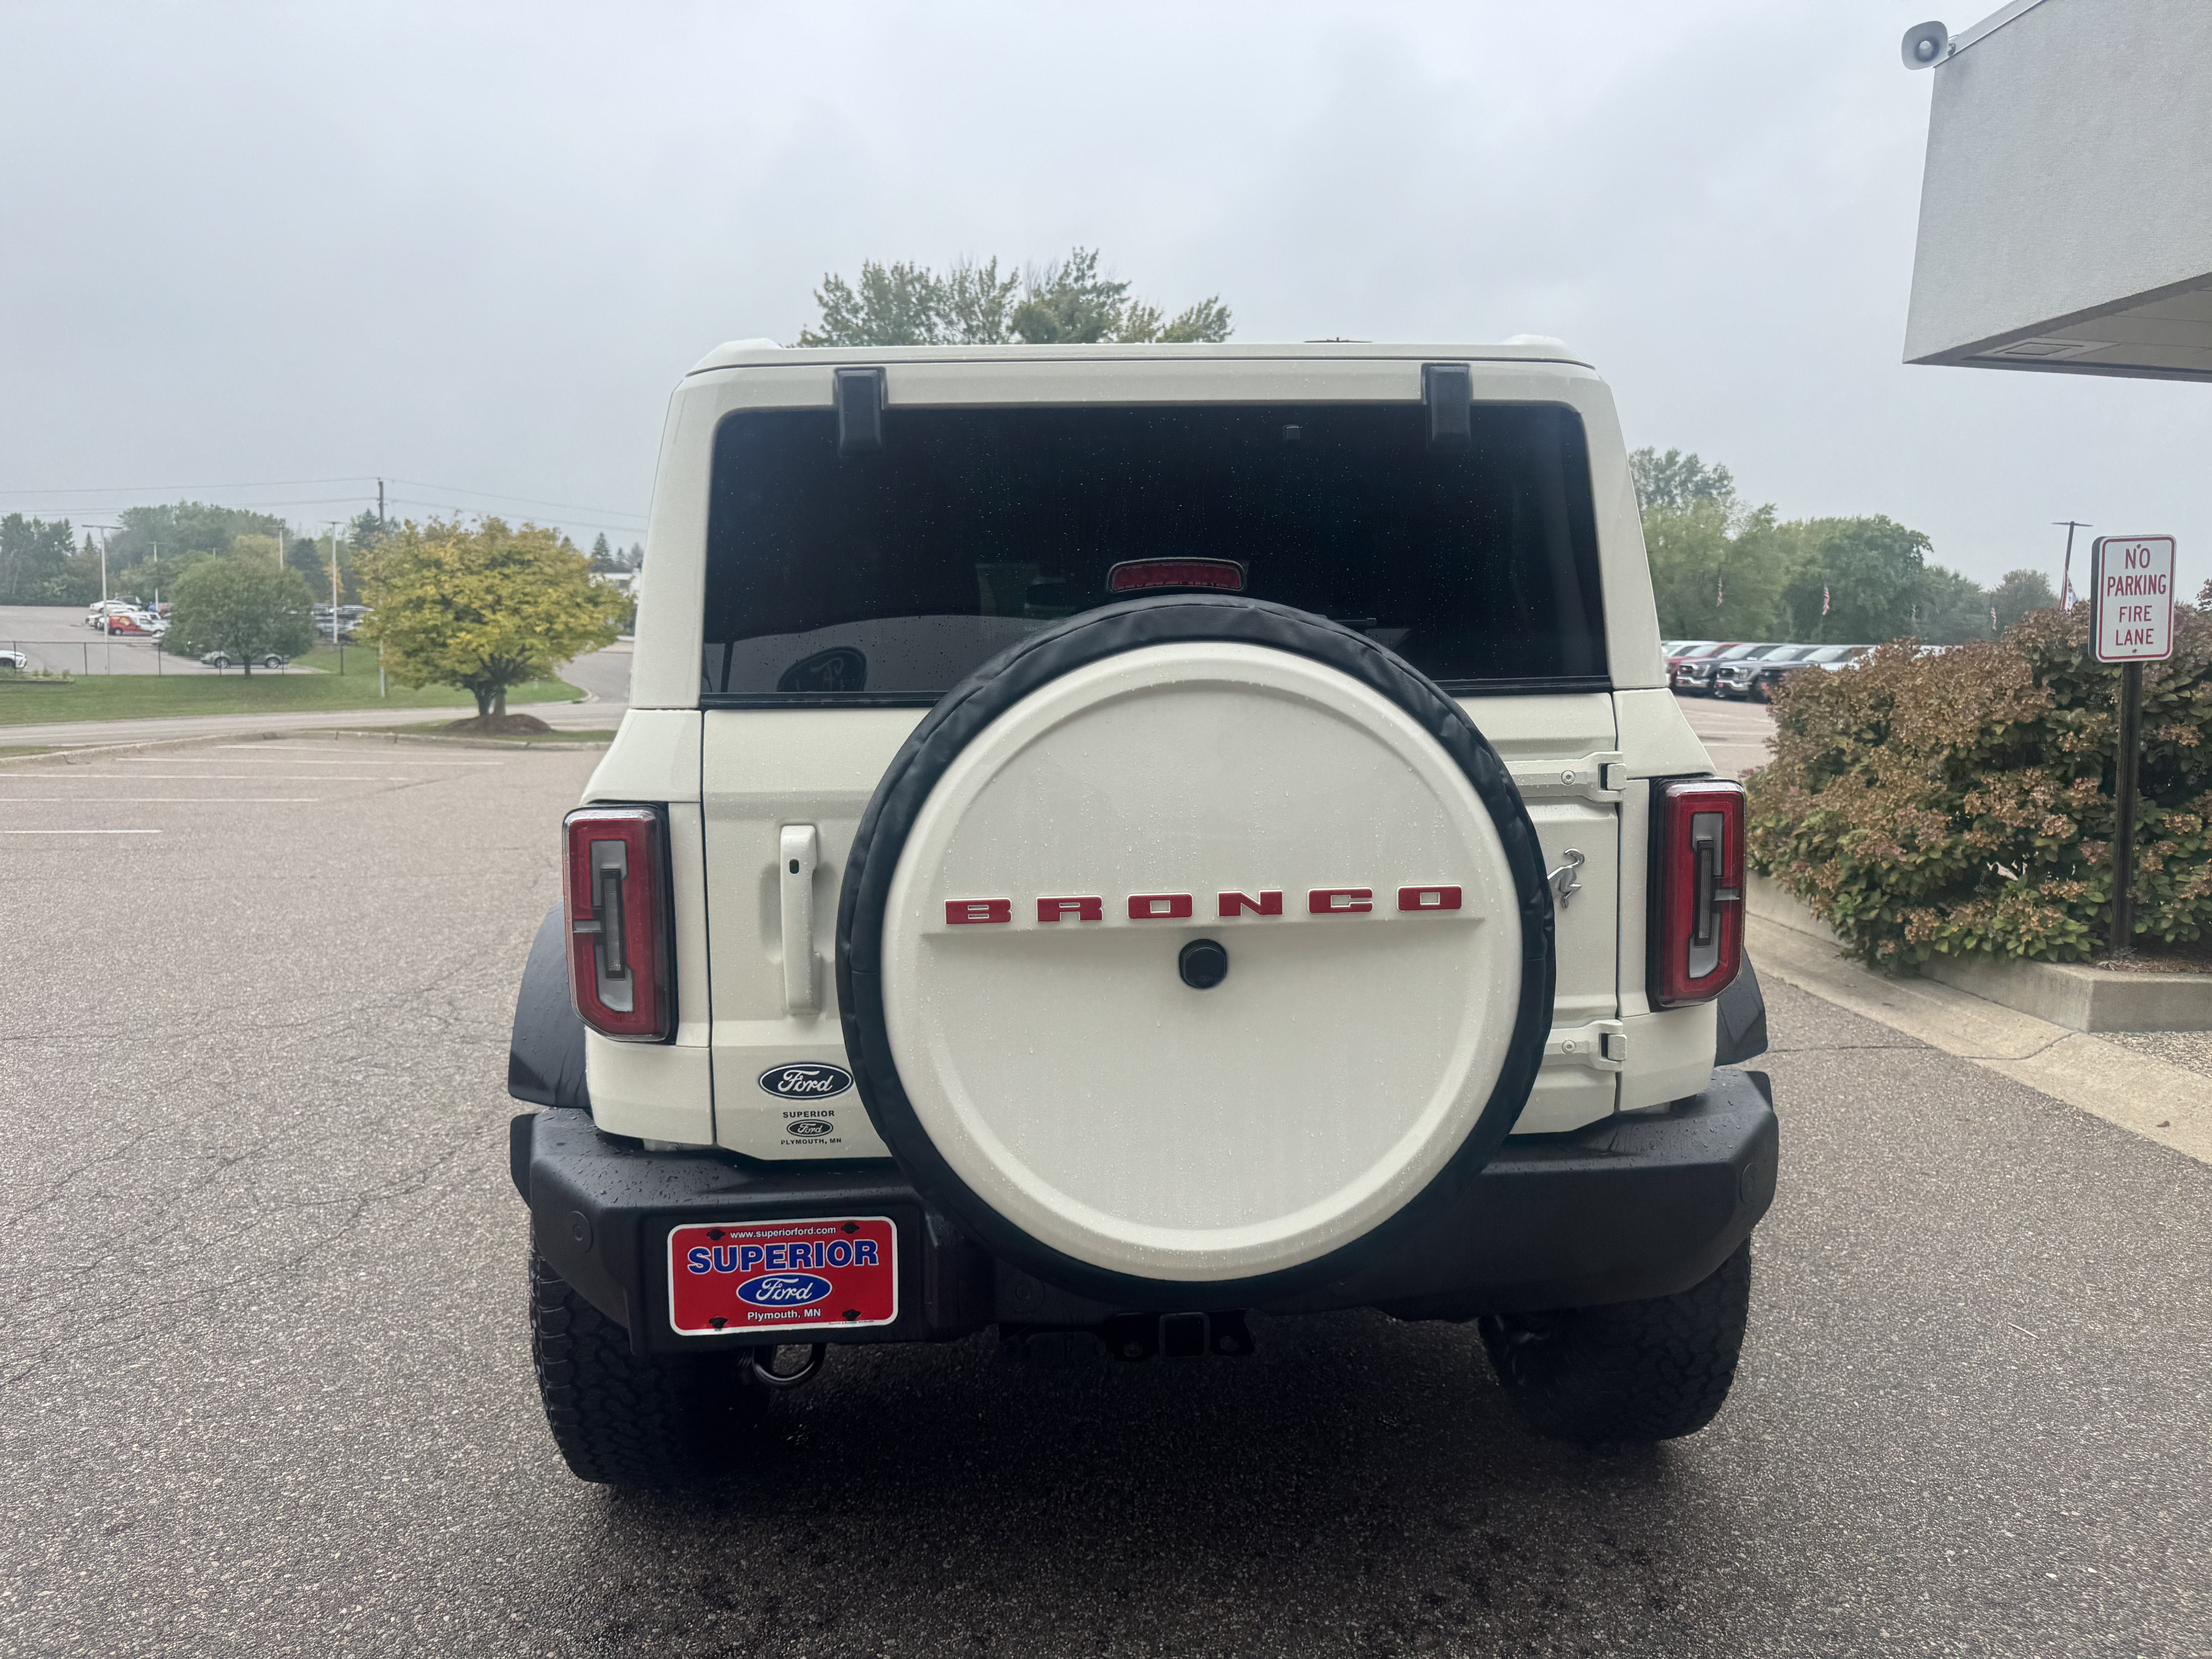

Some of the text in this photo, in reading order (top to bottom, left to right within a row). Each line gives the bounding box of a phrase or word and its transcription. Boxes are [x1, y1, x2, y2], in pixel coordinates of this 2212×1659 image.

[2125, 548, 2150, 569] NO
[2107, 574, 2167, 597] PARKING
[2119, 605, 2152, 623] FIRE
[2115, 628, 2154, 646] LANE
[944, 884, 1463, 925] BRONCO
[778, 1070, 834, 1092] Ford
[783, 1110, 835, 1118] SUPERIOR
[797, 1123, 823, 1134] Ford
[730, 1226, 836, 1239] www.superiorford.com
[687, 1239, 879, 1275] SUPERIOR
[756, 1278, 813, 1300] Ford
[747, 1308, 822, 1322] Plymouth, MN
